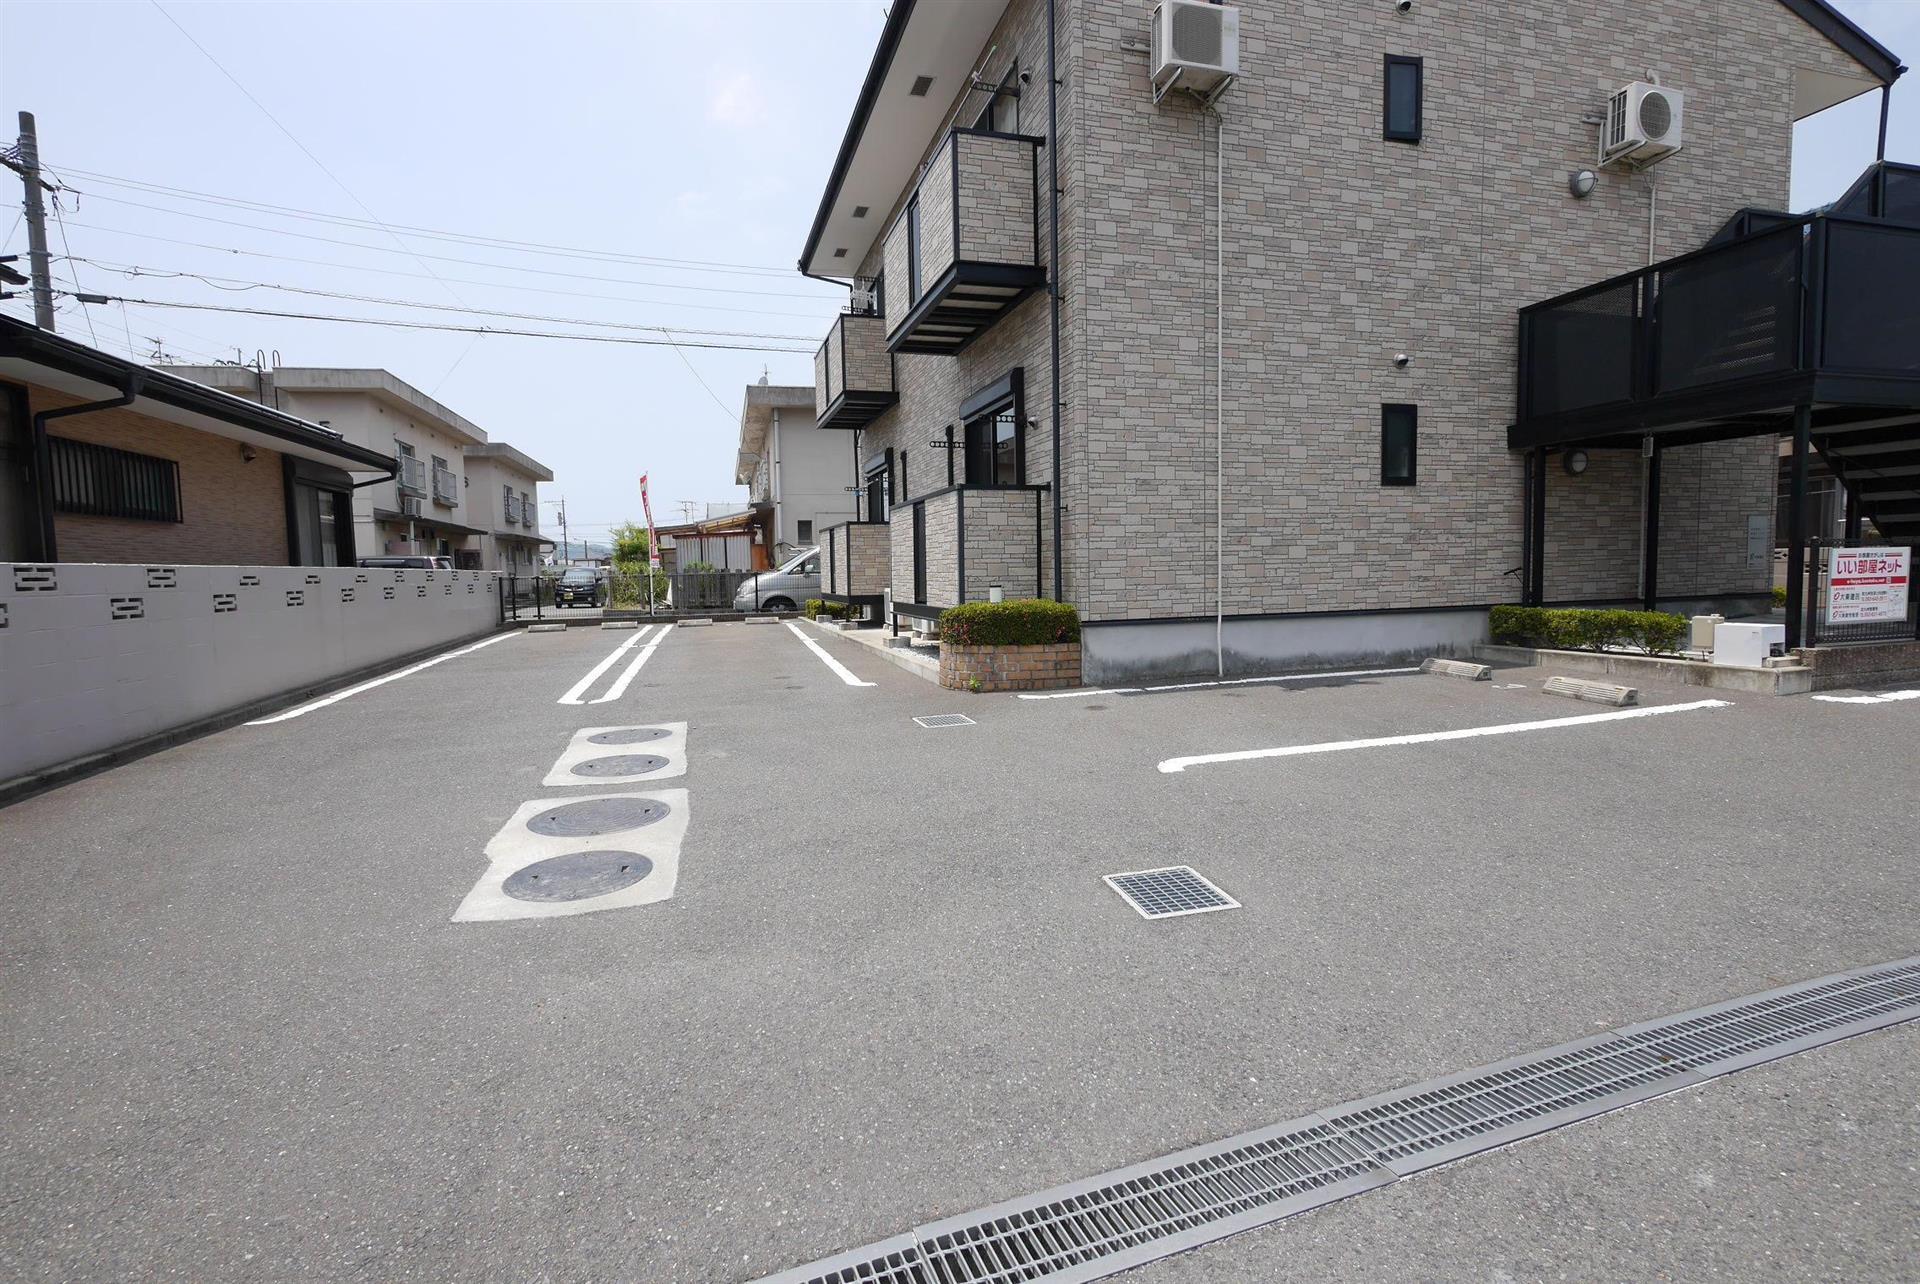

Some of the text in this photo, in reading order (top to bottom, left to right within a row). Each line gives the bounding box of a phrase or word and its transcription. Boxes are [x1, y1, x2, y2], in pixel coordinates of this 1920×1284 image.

[1836, 559, 1902, 574] いい部屋ネット
